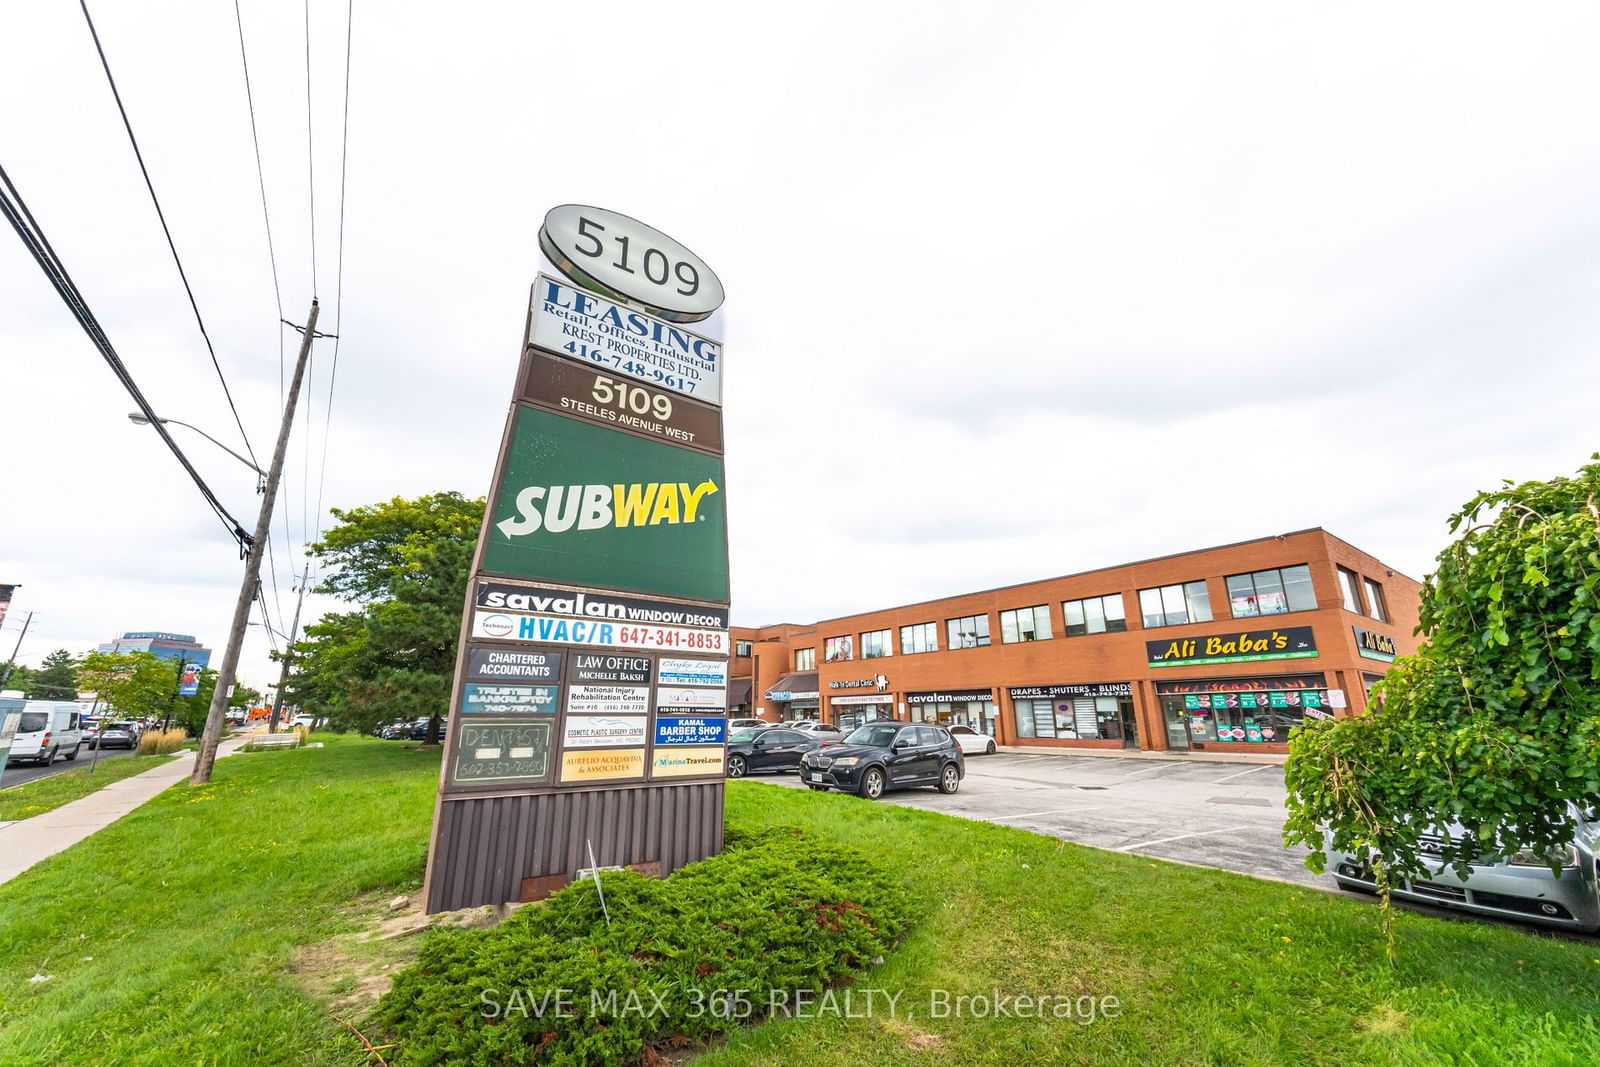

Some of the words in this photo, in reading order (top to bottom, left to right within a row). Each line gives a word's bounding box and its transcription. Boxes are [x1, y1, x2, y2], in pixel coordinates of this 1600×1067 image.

[575, 216, 700, 297] 5109
[544, 281, 717, 363] LEASING
[543, 302, 593, 329] Retail,
[597, 323, 649, 350] Offices,
[654, 343, 716, 373] Industrial
[562, 322, 605, 346] KREST
[607, 338, 676, 372] PROPERTIES
[678, 364, 703, 382] LTD.
[563, 340, 697, 394] 416-748-9617
[591, 375, 673, 421] 5109
[560, 397, 617, 421] STEELES
[618, 414, 663, 434] AVENUE
[664, 425, 696, 442] WEST
[496, 478, 719, 540] SUBWAY
[484, 591, 627, 619] savalan
[627, 607, 684, 623] WINDOW
[685, 613, 721, 627] DECOR
[518, 616, 613, 645] HVAC/R
[620, 626, 721, 650] 647-341-8853
[1164, 639, 1197, 659] Ali
[1205, 631, 1289, 655] Baba's
[488, 652, 546, 665] CHARTERED
[576, 655, 604, 669] LAW
[606, 656, 649, 671] OFFICE
[479, 664, 551, 677] ACCOUNTANTS
[579, 671, 618, 680] MICHELLE
[620, 672, 644, 681] BAKSH
[535, 688, 549, 696] IN
[571, 693, 621, 701] Rehabilitation
[622, 694, 646, 702] Centre
[583, 686, 614, 694] National
[615, 687, 635, 695] Injury
[907, 692, 953, 703] savalan
[953, 694, 977, 702] WINDOW
[1010, 687, 1042, 696] DRAPES
[1049, 685, 1090, 695] SHUTTERS
[1099, 683, 1133, 692] BLINDS
[659, 726, 697, 736] BARBER
[697, 726, 722, 735] SHOP
[567, 757, 600, 766] AURELIO
[600, 755, 642, 764] ACQUAVIVA
[586, 764, 630, 773] ASSOCIATES
